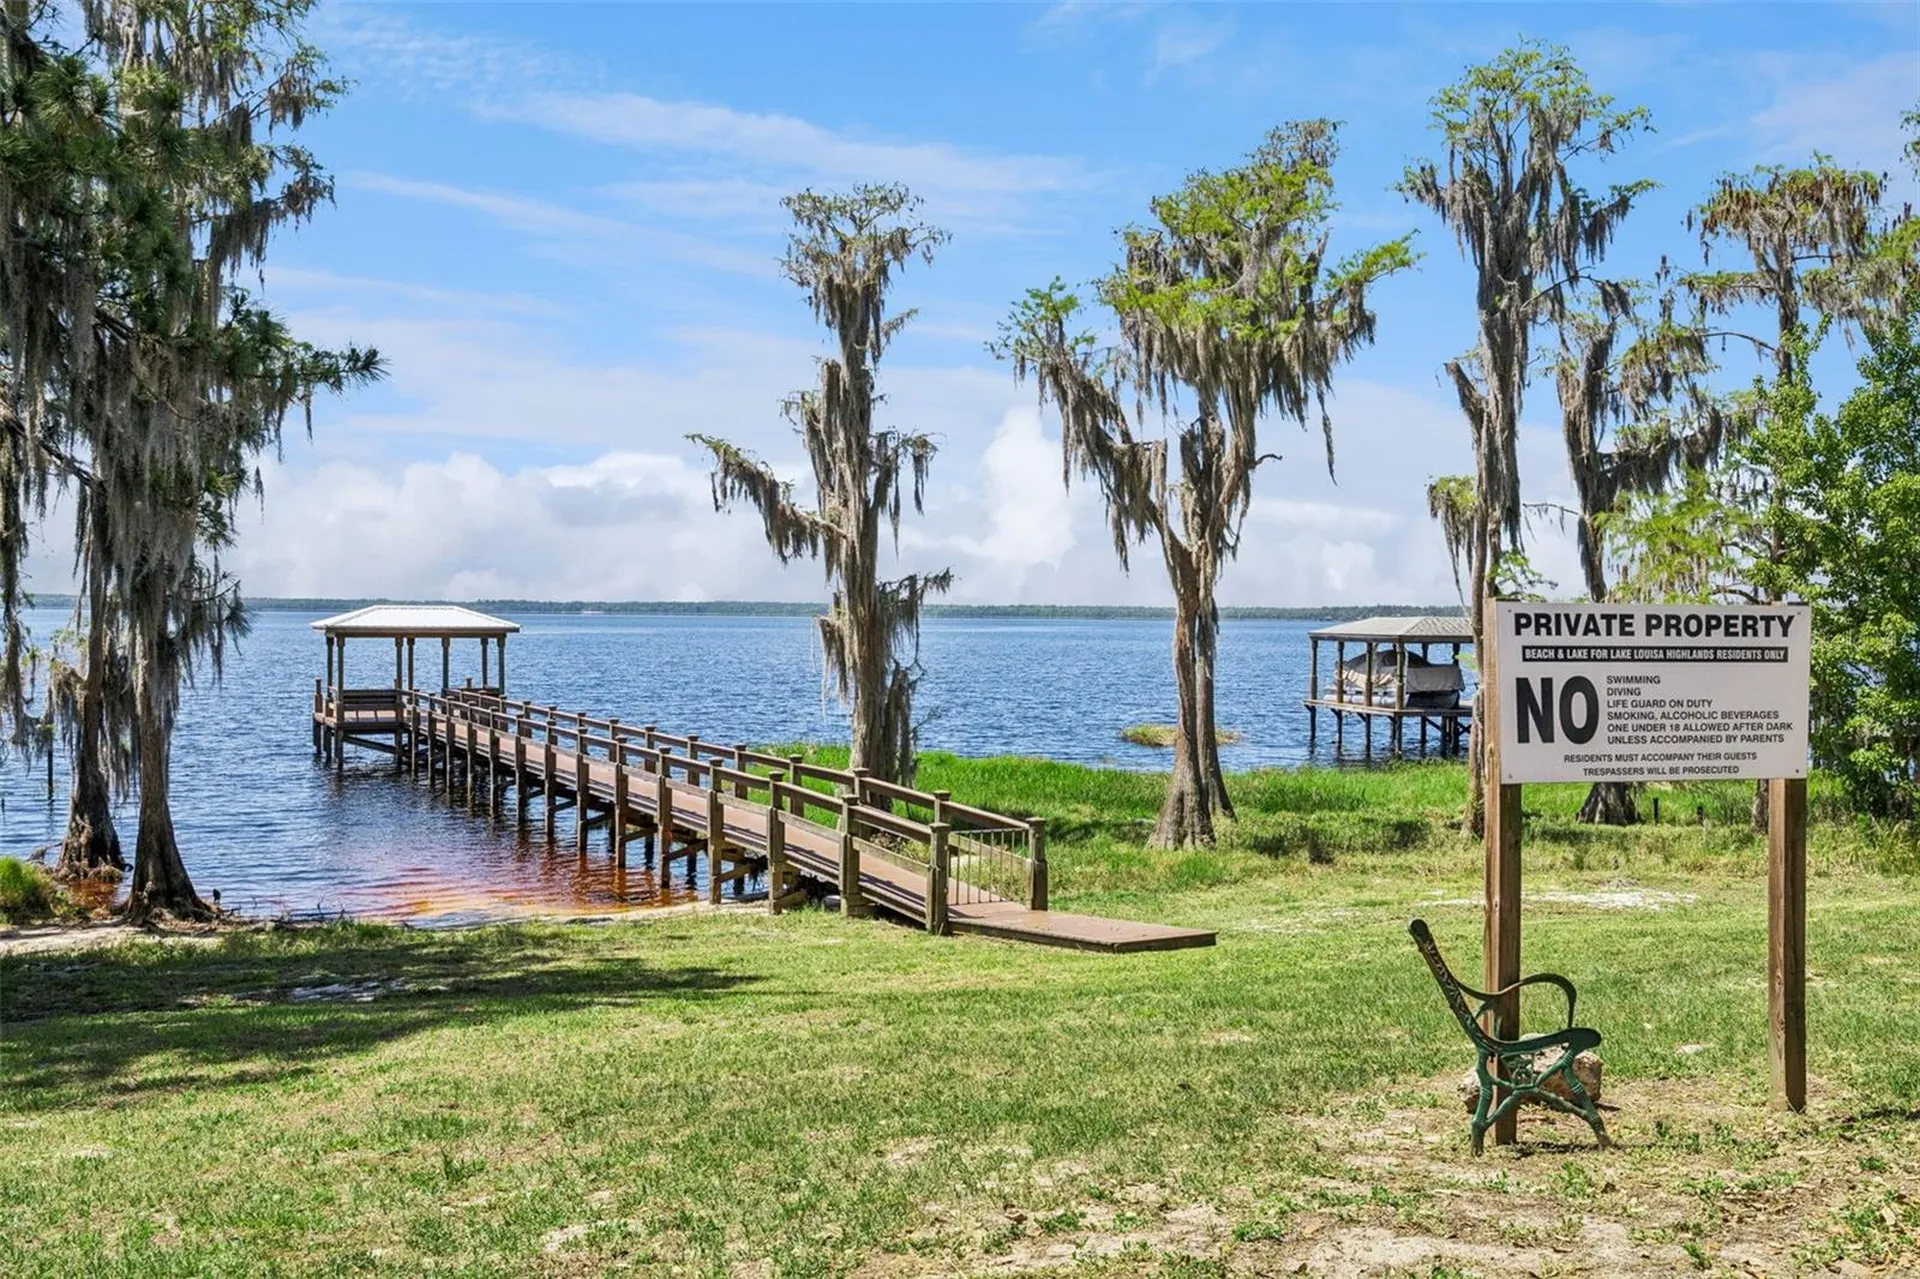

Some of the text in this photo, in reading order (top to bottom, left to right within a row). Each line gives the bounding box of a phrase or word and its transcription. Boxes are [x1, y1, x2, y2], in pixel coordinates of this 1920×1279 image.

[1514, 613, 1794, 637] PRIVATE PROPERTY
[1525, 649, 1784, 659] BEACH & LAKE FOR LAKE LOUISA HIGHLANDS RESIDENTS ONLY
[1607, 675, 1660, 684] SWIMMING
[1607, 688, 1641, 696] DIVING
[1607, 699, 1712, 708] LIFE GUARD ON DUTY
[1515, 675, 1599, 744] NO
[1607, 711, 1778, 721] SMOKING, ALCOHOLIC BEVERAGES
[1608, 722, 1793, 732] ONE UNDER 18 ALLOWED AFTER DARK
[1608, 734, 1784, 744] UNLESS ACCOMPANIED BY PARENTS
[1564, 752, 1757, 763] RESIDENTS MUST ACCOMPANY THEIR GUESTS
[1583, 766, 1739, 776] TRESPASSERS WILL BE PROSECUTED
